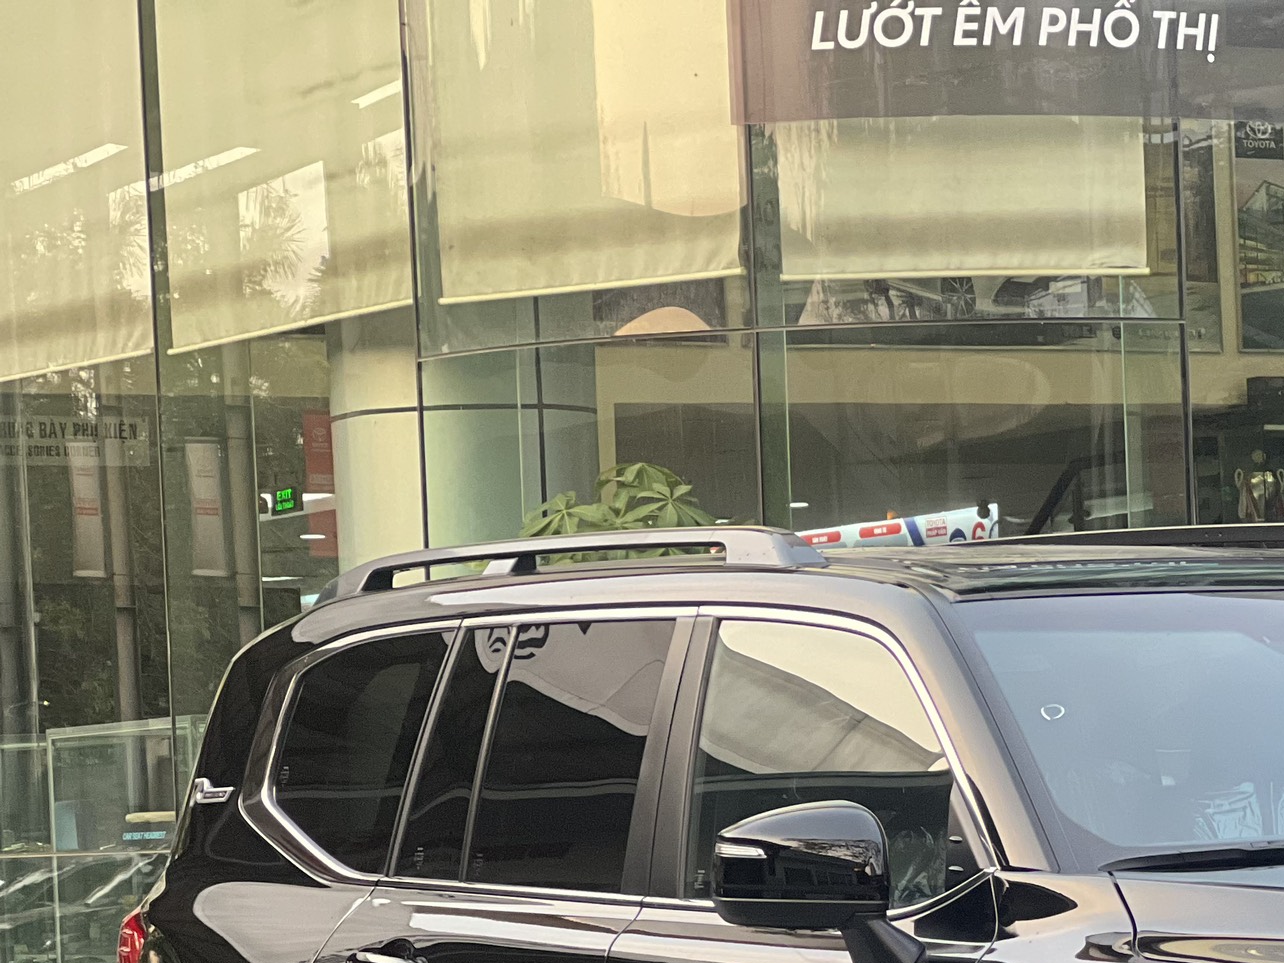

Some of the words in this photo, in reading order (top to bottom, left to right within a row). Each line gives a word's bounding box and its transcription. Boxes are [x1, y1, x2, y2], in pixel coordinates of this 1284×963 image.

[811, 0, 943, 50] LƯỚT
[953, 0, 1026, 46] ÊM
[1152, 10, 1219, 63] THỊ
[1243, 140, 1276, 149] TOYOTA
